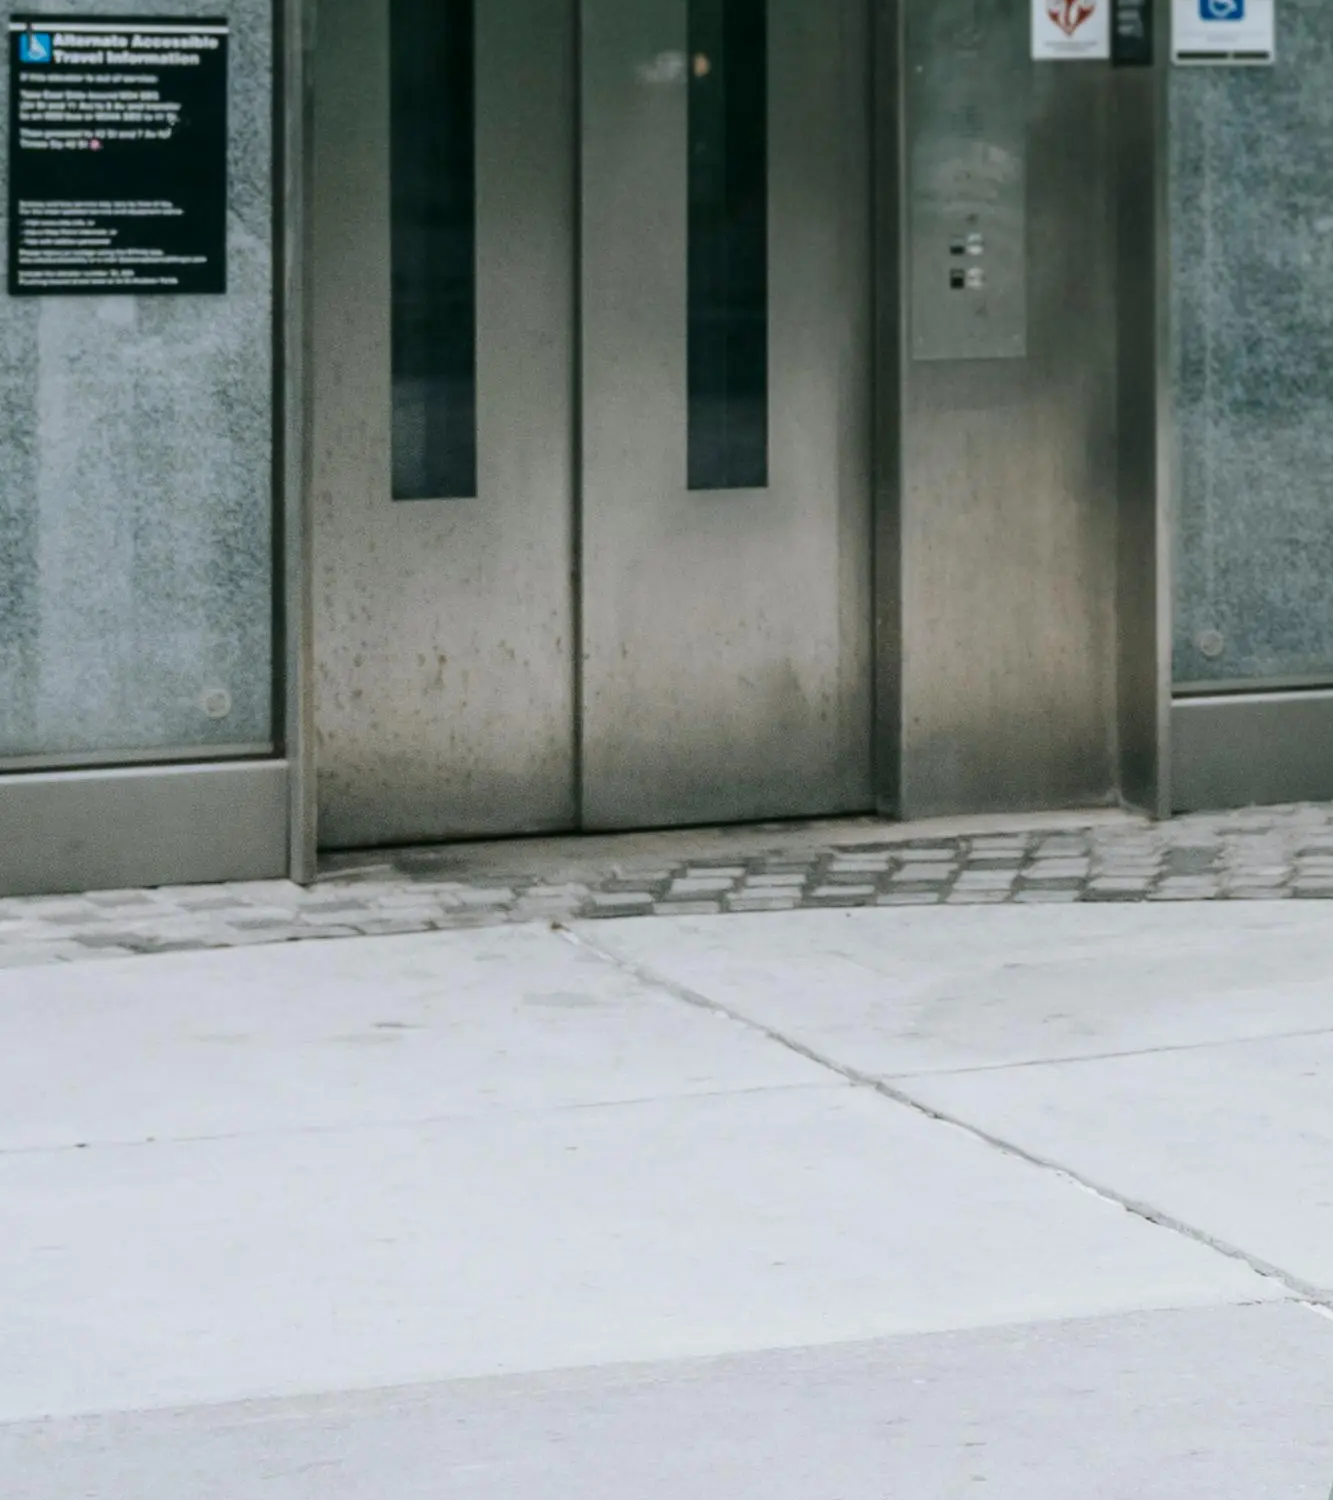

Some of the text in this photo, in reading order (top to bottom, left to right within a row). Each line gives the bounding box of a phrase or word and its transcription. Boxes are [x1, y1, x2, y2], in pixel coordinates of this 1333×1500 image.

[131, 34, 219, 49] Accessible
[53, 50, 200, 65] Travel Information
